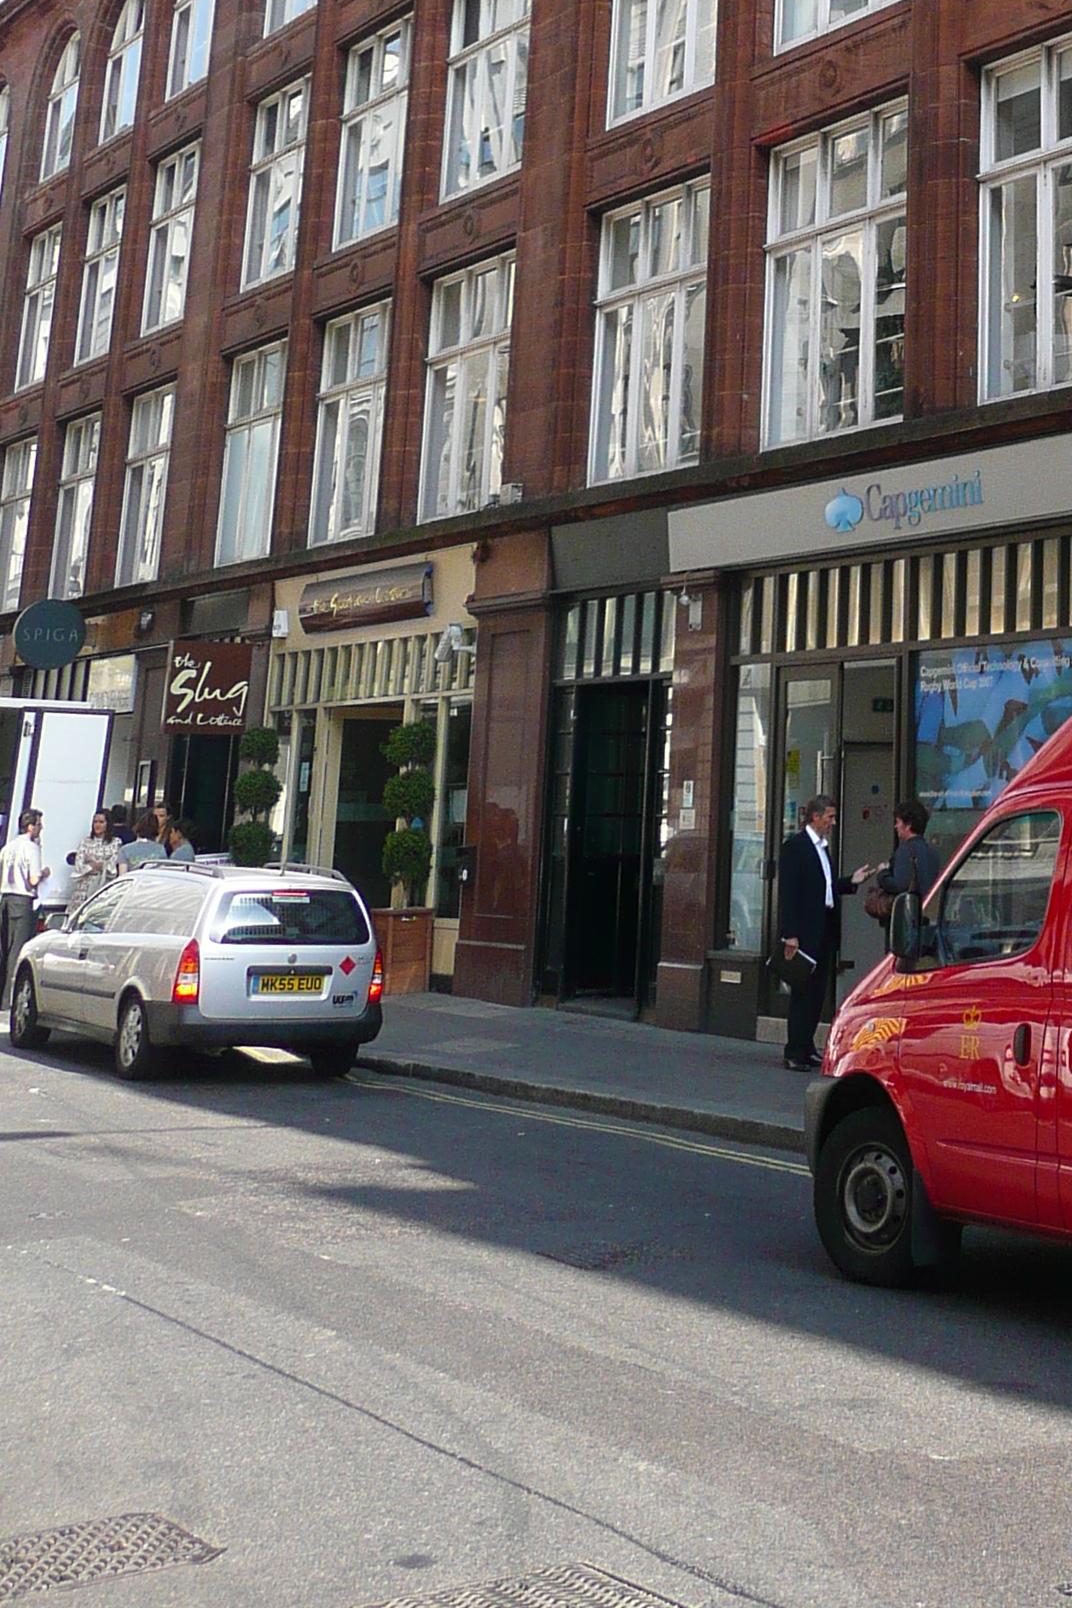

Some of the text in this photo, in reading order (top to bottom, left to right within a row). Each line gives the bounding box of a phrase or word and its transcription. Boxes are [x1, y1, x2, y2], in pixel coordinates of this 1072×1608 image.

[865, 470, 984, 530] Capgemini
[23, 628, 79, 642] SPIGA
[173, 652, 201, 668] the
[920, 664, 954, 679] Capgemini
[170, 661, 249, 717] Slug
[920, 680, 942, 694] Rugby
[942, 678, 962, 690] World
[963, 677, 978, 690] Cup
[166, 711, 244, 727] and Lettuce
[261, 978, 294, 992] MK55
[960, 1035, 980, 1060] ER
[943, 1079, 997, 1095] www.royalmail.com
